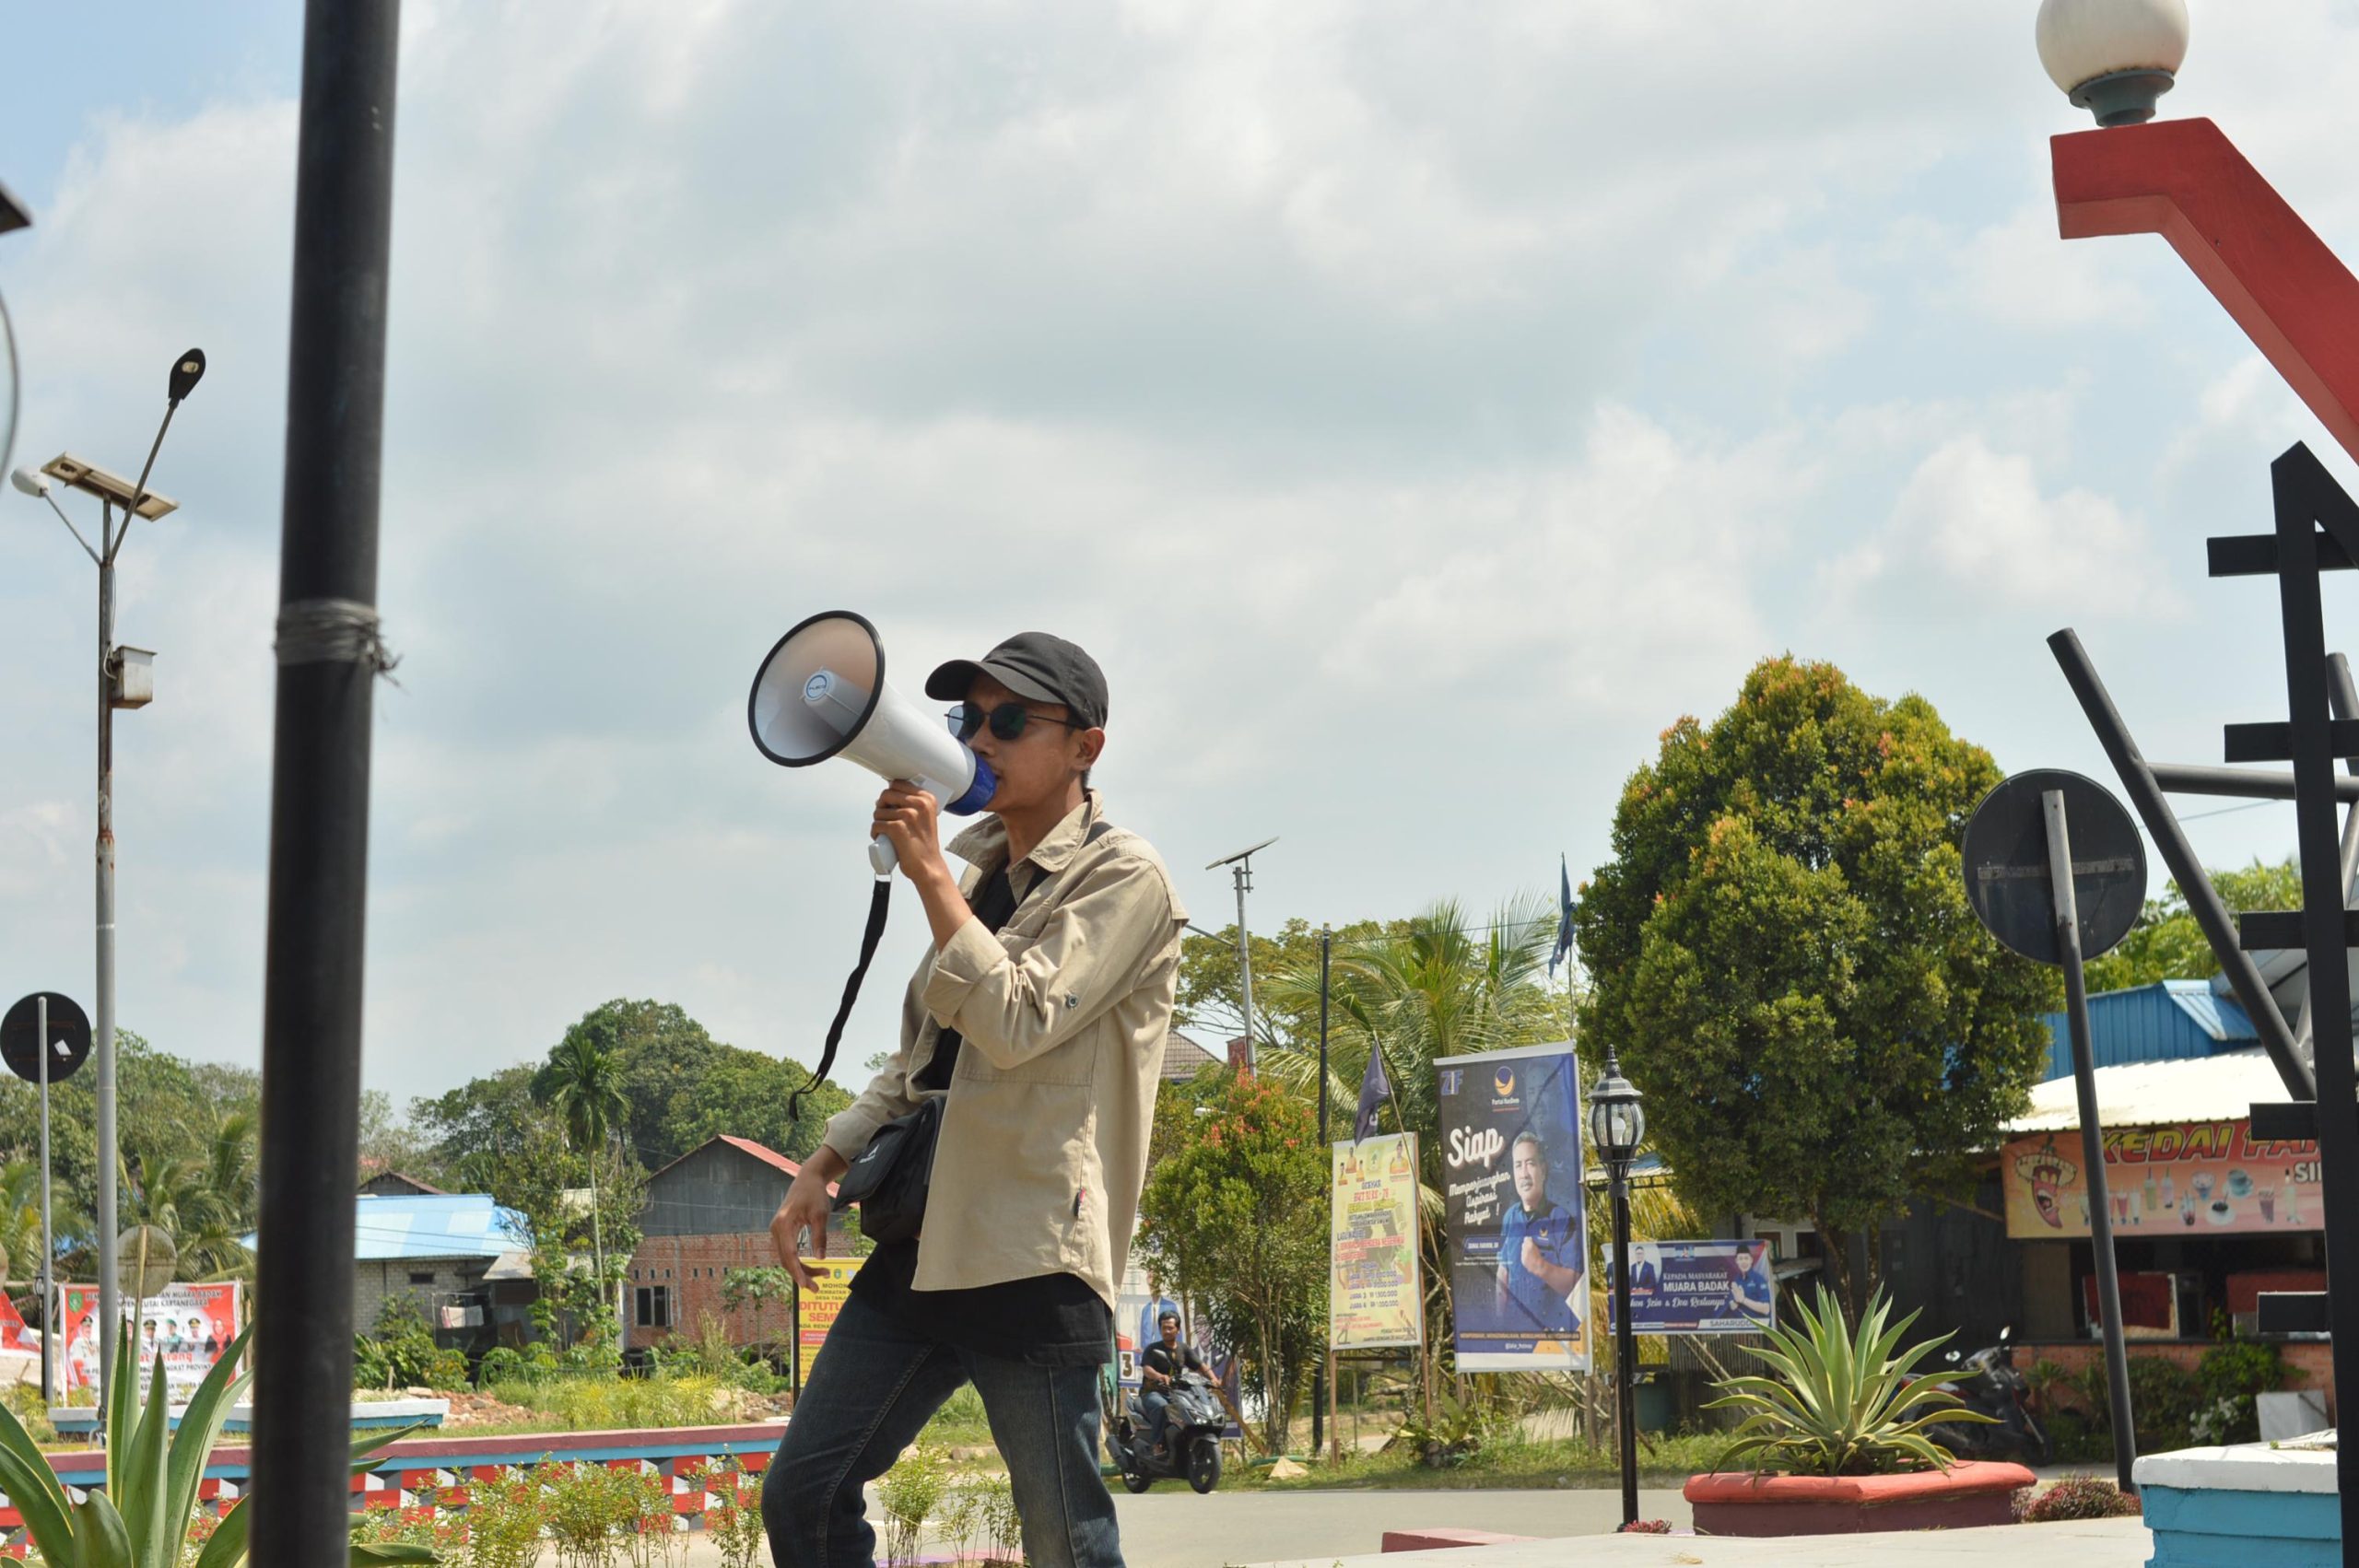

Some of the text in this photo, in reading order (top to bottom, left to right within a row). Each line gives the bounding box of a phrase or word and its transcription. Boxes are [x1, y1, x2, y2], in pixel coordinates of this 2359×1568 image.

[1448, 1125, 1504, 1167] Siap
[2102, 1126, 2234, 1164] KEDAI
[1449, 1171, 1510, 1197] Memperjuangkan
[1467, 1192, 1497, 1209] Aspirasi
[1464, 1206, 1491, 1226] Rakyat
[1663, 1281, 1696, 1293] MUARA
[1698, 1281, 1730, 1292] BADAK
[800, 1301, 840, 1311] DITUTU
[1121, 1353, 1133, 1377] 3
